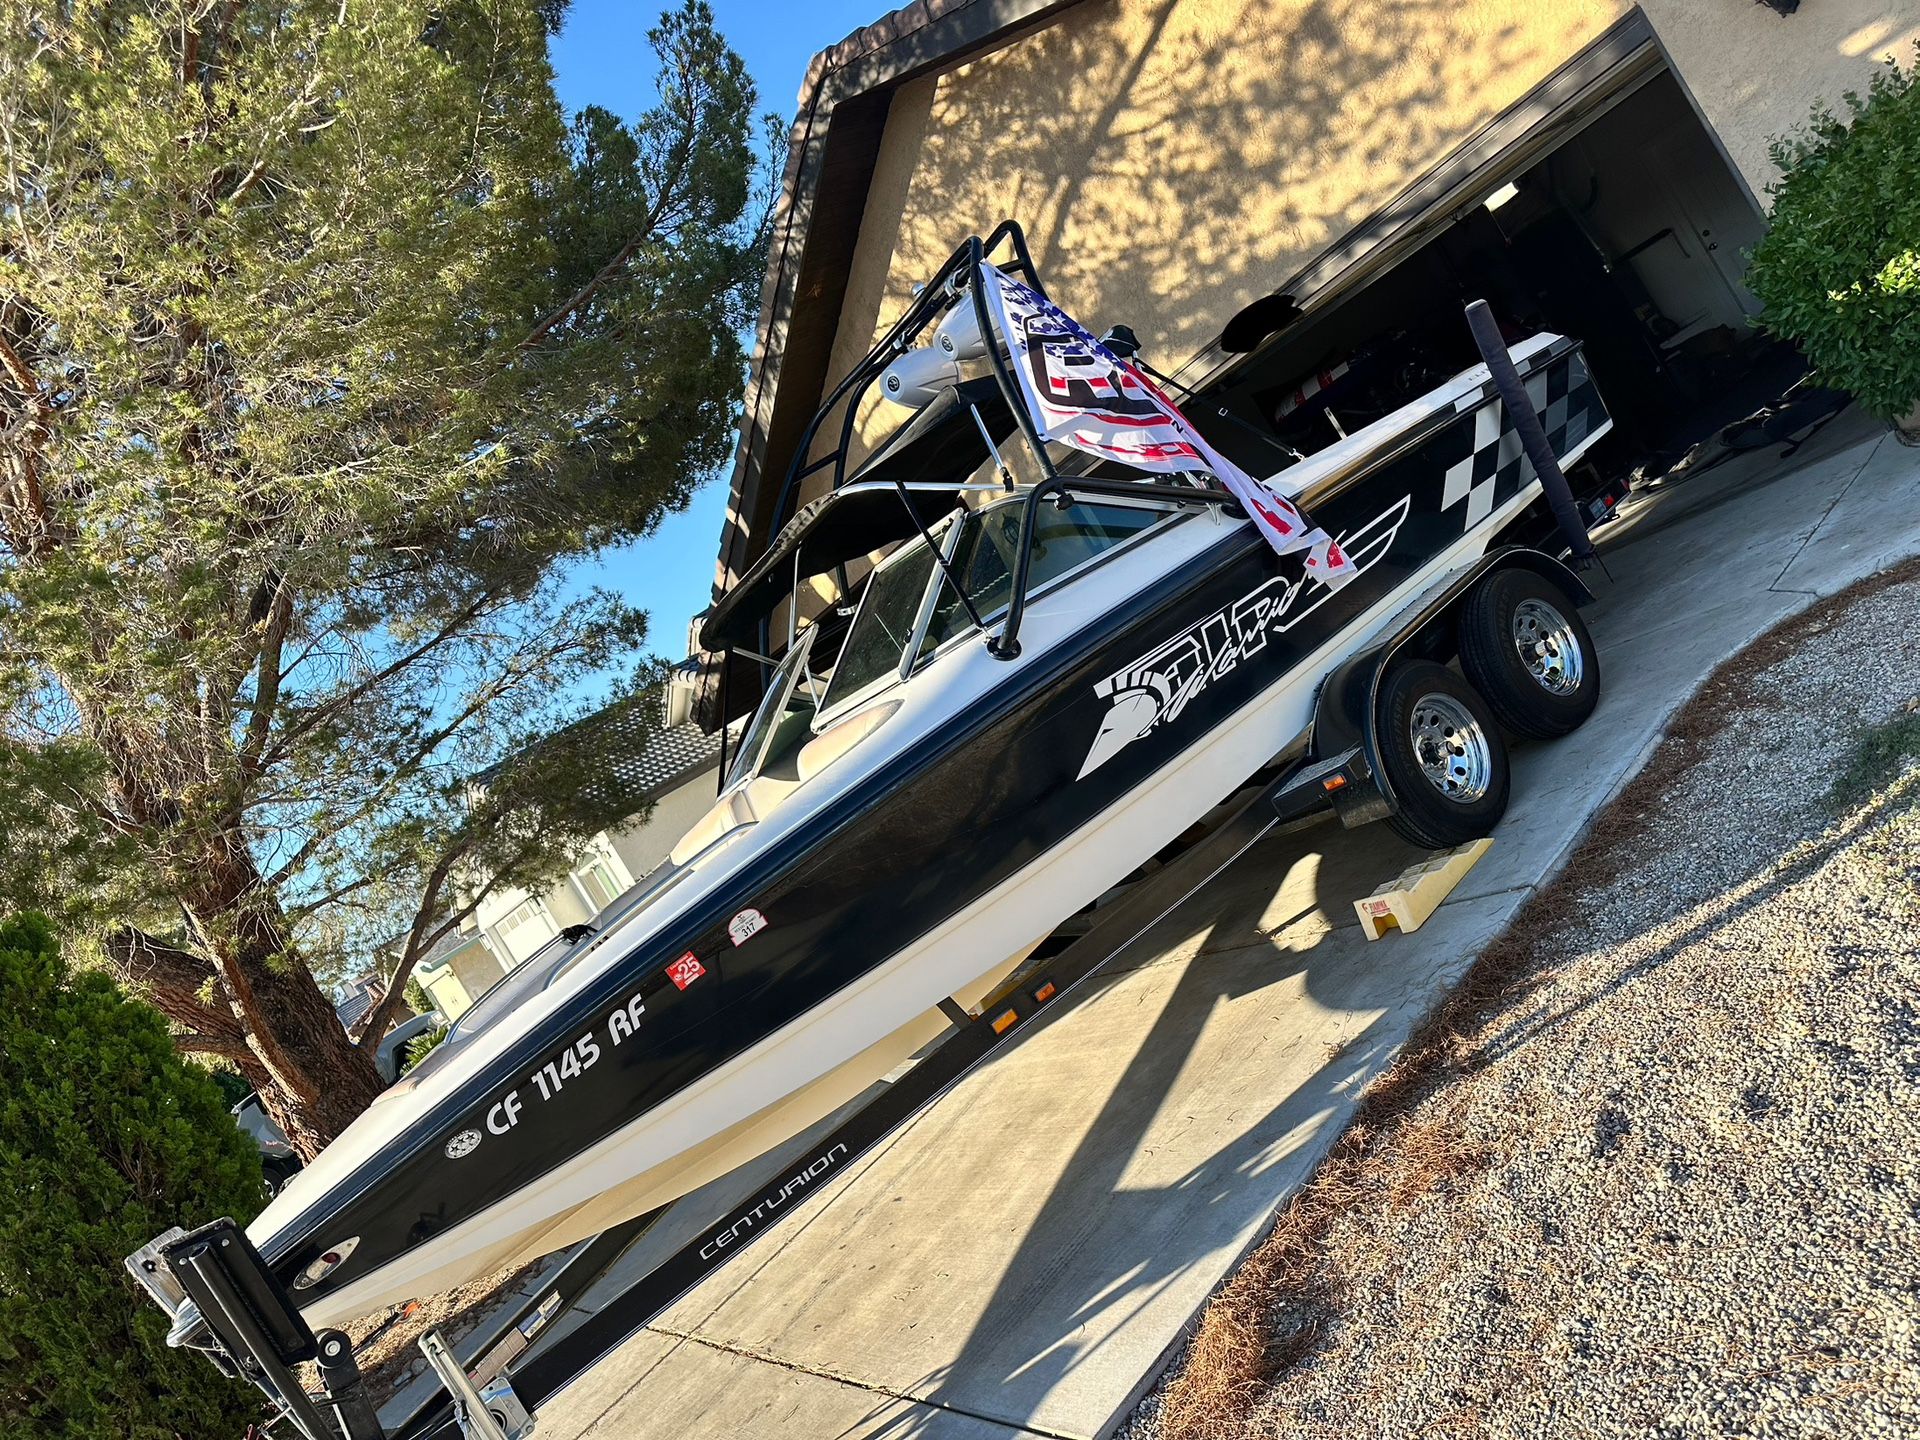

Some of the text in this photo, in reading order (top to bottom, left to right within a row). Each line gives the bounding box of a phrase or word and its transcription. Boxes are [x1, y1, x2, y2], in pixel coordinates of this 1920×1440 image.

[742, 922, 756, 937] 317
[677, 956, 700, 979] 25
[486, 993, 646, 1136] CF 1145 RF
[699, 1143, 848, 1260] CENTURION
